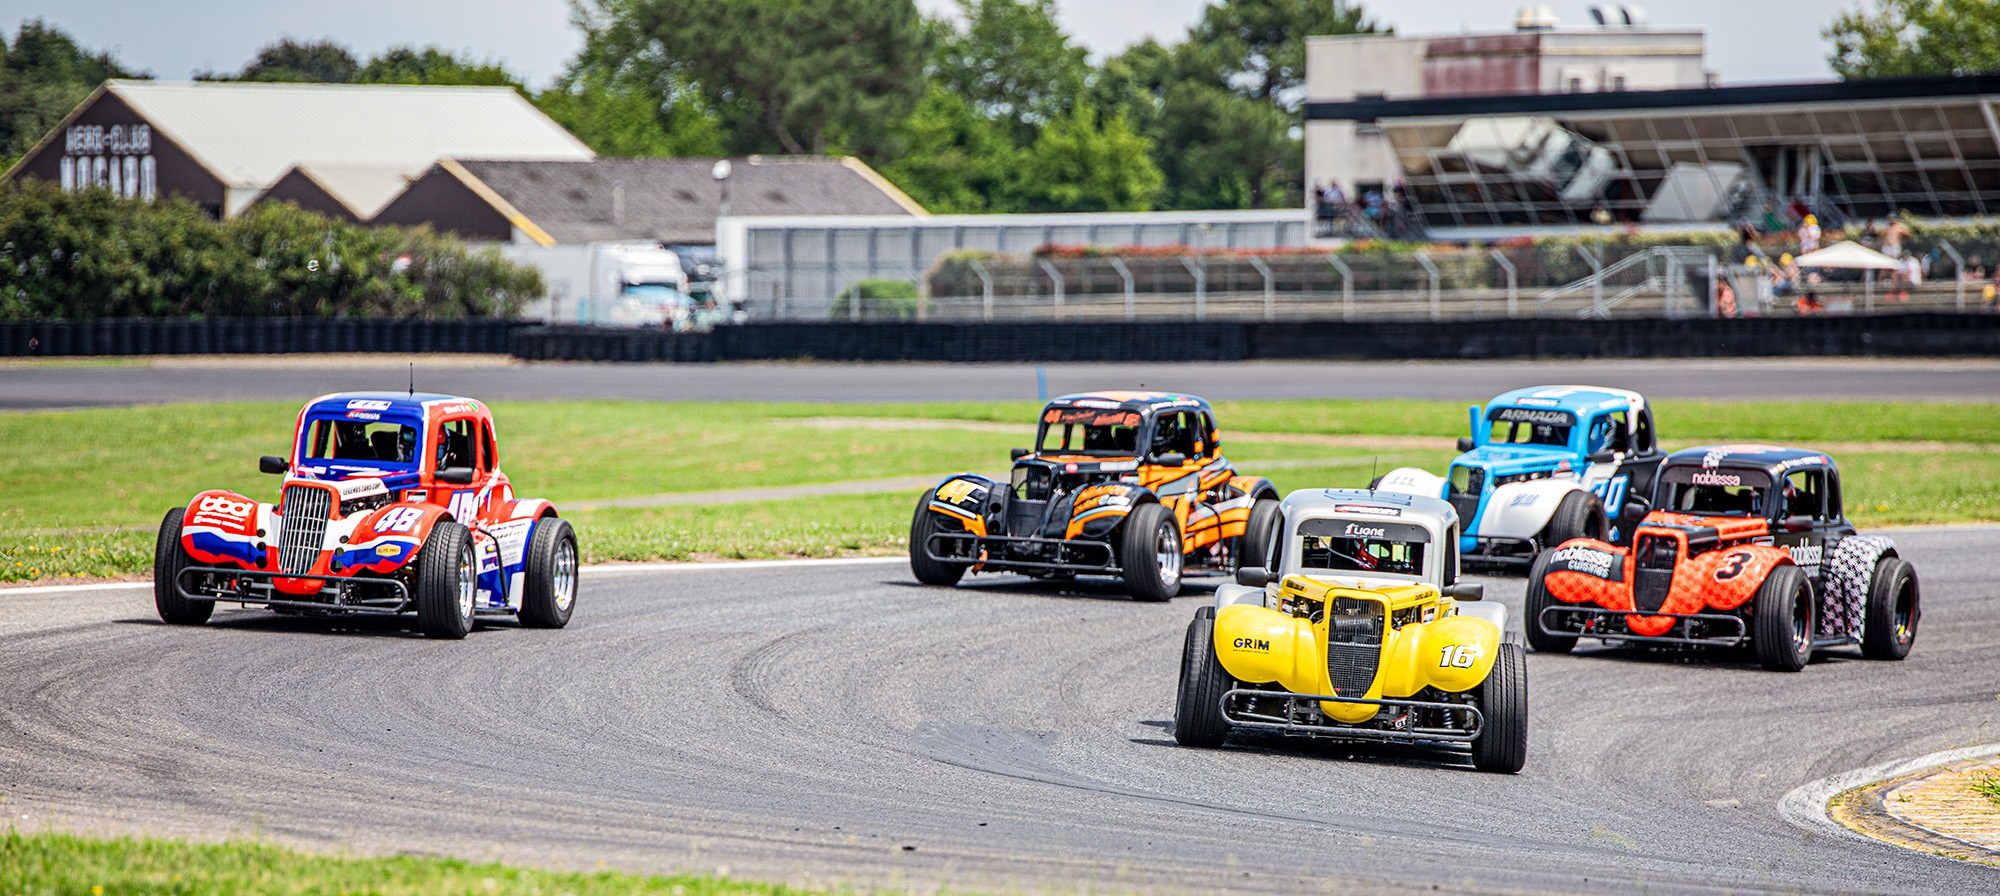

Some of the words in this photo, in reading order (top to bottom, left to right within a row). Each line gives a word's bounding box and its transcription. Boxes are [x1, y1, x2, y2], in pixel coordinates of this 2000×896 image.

[1500, 408, 1568, 423] ARMADA
[1692, 470, 1740, 486] noblessa
[373, 507, 424, 533] 48
[1353, 527, 1385, 536] LIGNE
[1550, 545, 1614, 568] noblessa
[1567, 560, 1610, 578] cuisines
[1713, 550, 1755, 583] 3
[1233, 637, 1270, 651] GRIM
[1439, 644, 1476, 669] 16
